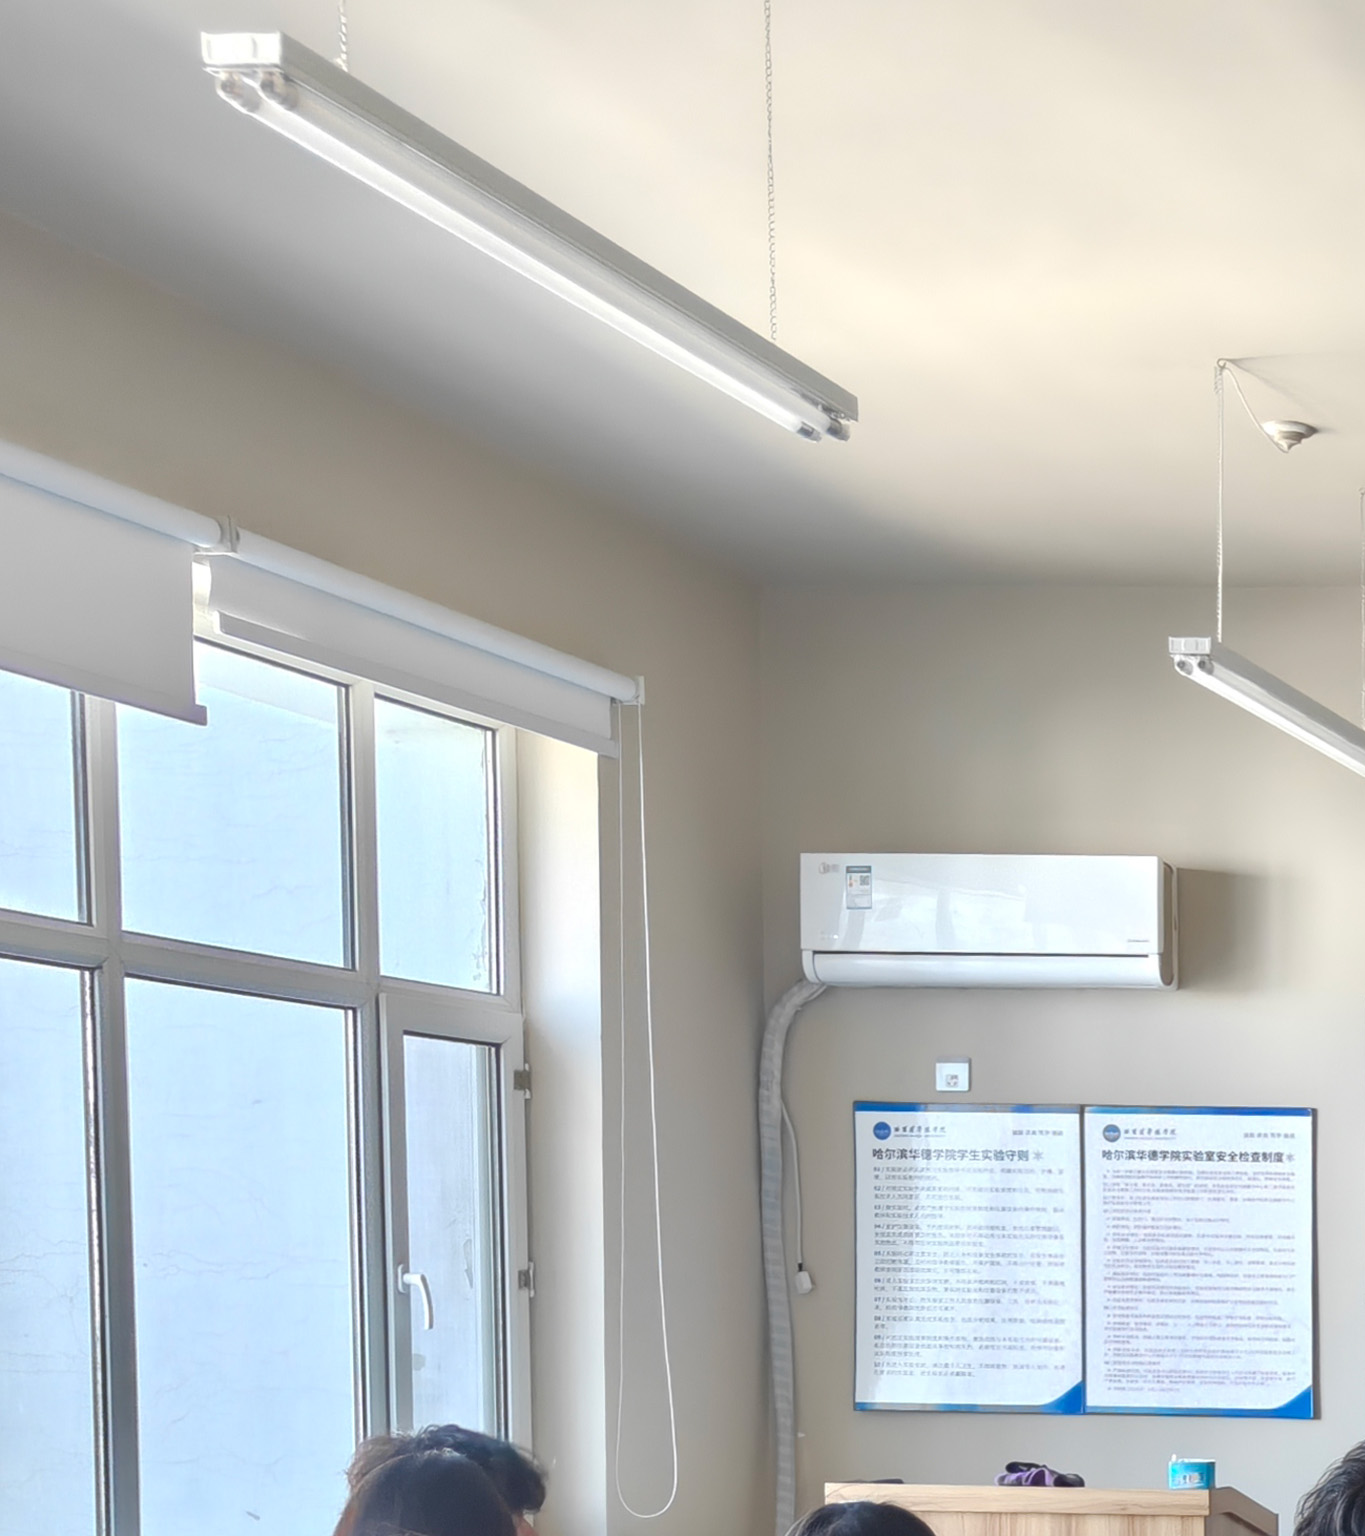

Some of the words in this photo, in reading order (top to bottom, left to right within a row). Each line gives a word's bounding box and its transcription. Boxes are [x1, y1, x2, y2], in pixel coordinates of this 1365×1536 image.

[872, 1148, 1030, 1162] 哈尔滨华德学院学生实验守则
[1102, 1150, 1285, 1163] 哈尔滨华德学院实验室安全检查制度
